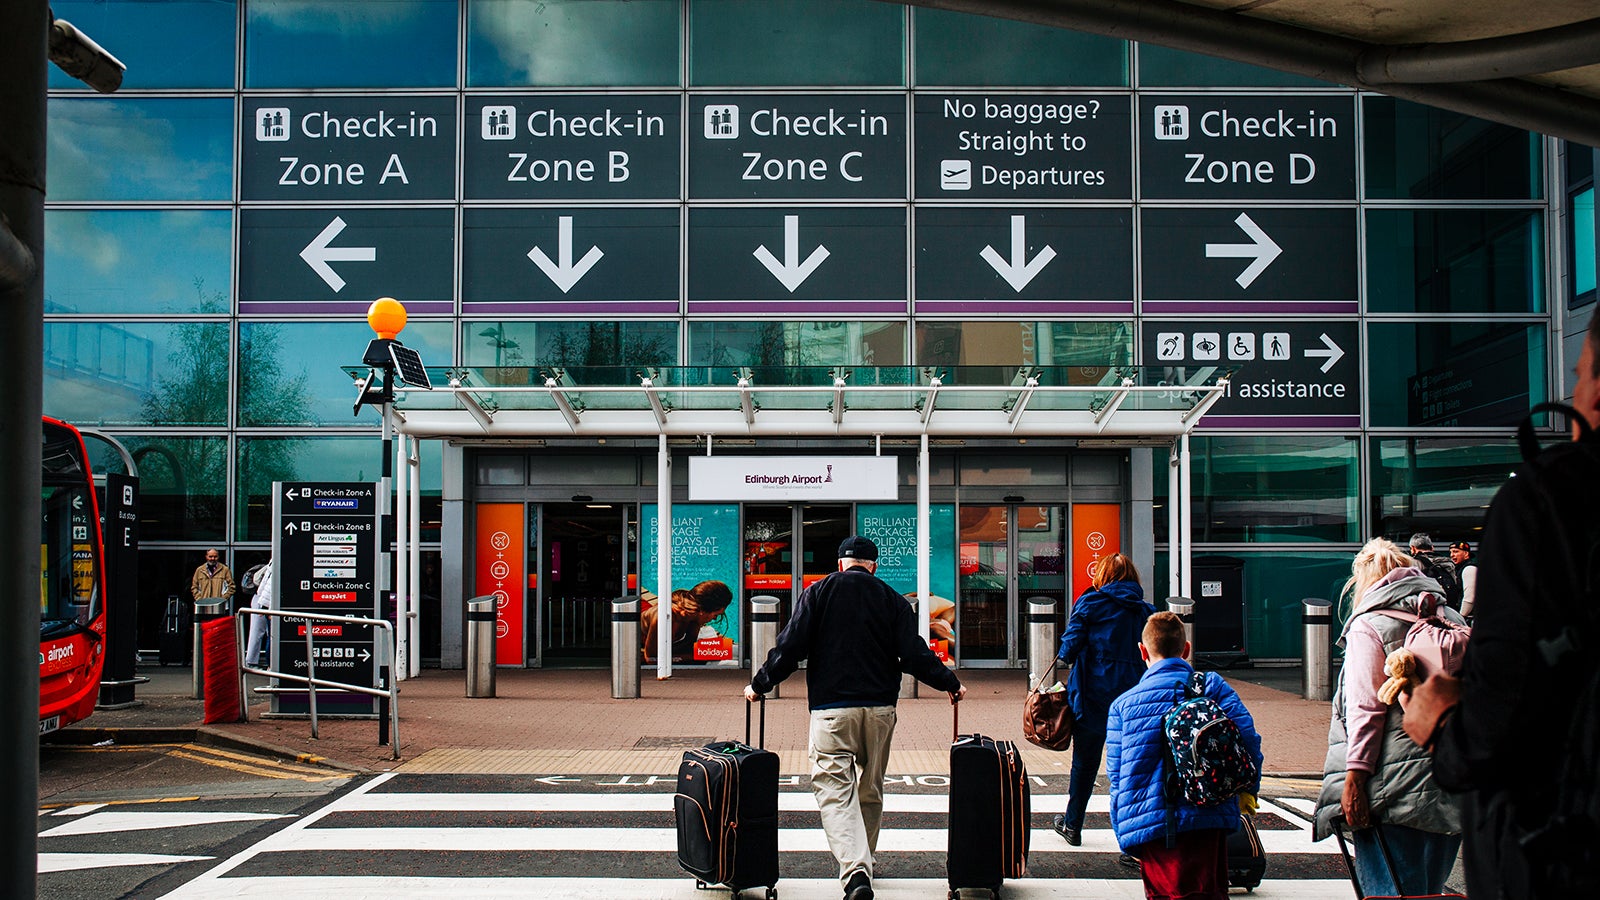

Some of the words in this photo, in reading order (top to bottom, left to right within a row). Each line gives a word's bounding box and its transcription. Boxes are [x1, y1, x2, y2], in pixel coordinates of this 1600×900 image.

[944, 98, 977, 119] No
[985, 97, 1100, 123] baggage?
[301, 110, 437, 138] Check-in
[527, 108, 664, 137] Check-in
[750, 108, 888, 136] Check-in
[1200, 109, 1337, 138] Check-in
[958, 129, 1054, 155] Straight
[1060, 131, 1087, 151] to
[278, 156, 365, 186] Zone
[378, 153, 409, 185] A
[507, 153, 595, 183] Zone
[608, 150, 630, 183] B
[741, 152, 828, 181] Zone
[839, 151, 863, 182] C
[1184, 153, 1274, 184] Zone
[1289, 153, 1316, 184] D
[981, 164, 1106, 190] Departures
[1156, 379, 1231, 404] Specl
[1239, 379, 1346, 398] assistance
[745, 474, 790, 486] Edinburgh
[791, 474, 823, 485] Airport
[313, 488, 344, 497] Check-in
[345, 488, 364, 497] Zone
[364, 488, 372, 497] A
[118, 511, 127, 519] Bus
[126, 511, 137, 521] stop
[313, 522, 344, 531] Check-in
[345, 522, 364, 531] Zone
[364, 522, 372, 531] B
[650, 517, 703, 526] BLIANT
[864, 517, 918, 527] BRILLIANT
[650, 527, 700, 536] PKAGE
[864, 527, 914, 537] PACKAGE
[124, 527, 132, 547] E
[650, 536, 703, 546] HIDAYS
[703, 536, 718, 546] AT
[868, 537, 917, 547] OLIDAYS
[650, 546, 719, 556] UEATABLE
[877, 546, 933, 556] BEATABE
[650, 555, 689, 565] PES.
[875, 556, 904, 566] ICES.
[312, 581, 344, 590] Check-in
[345, 581, 364, 590] Zone
[364, 581, 371, 590] C
[321, 593, 347, 601] easyJet
[303, 626, 339, 635] Jt2.com
[47, 642, 74, 662] airport
[697, 647, 729, 658] holidays
[294, 659, 319, 668] Specl
[319, 659, 355, 668] assistance
[883, 775, 1048, 787] LOK
